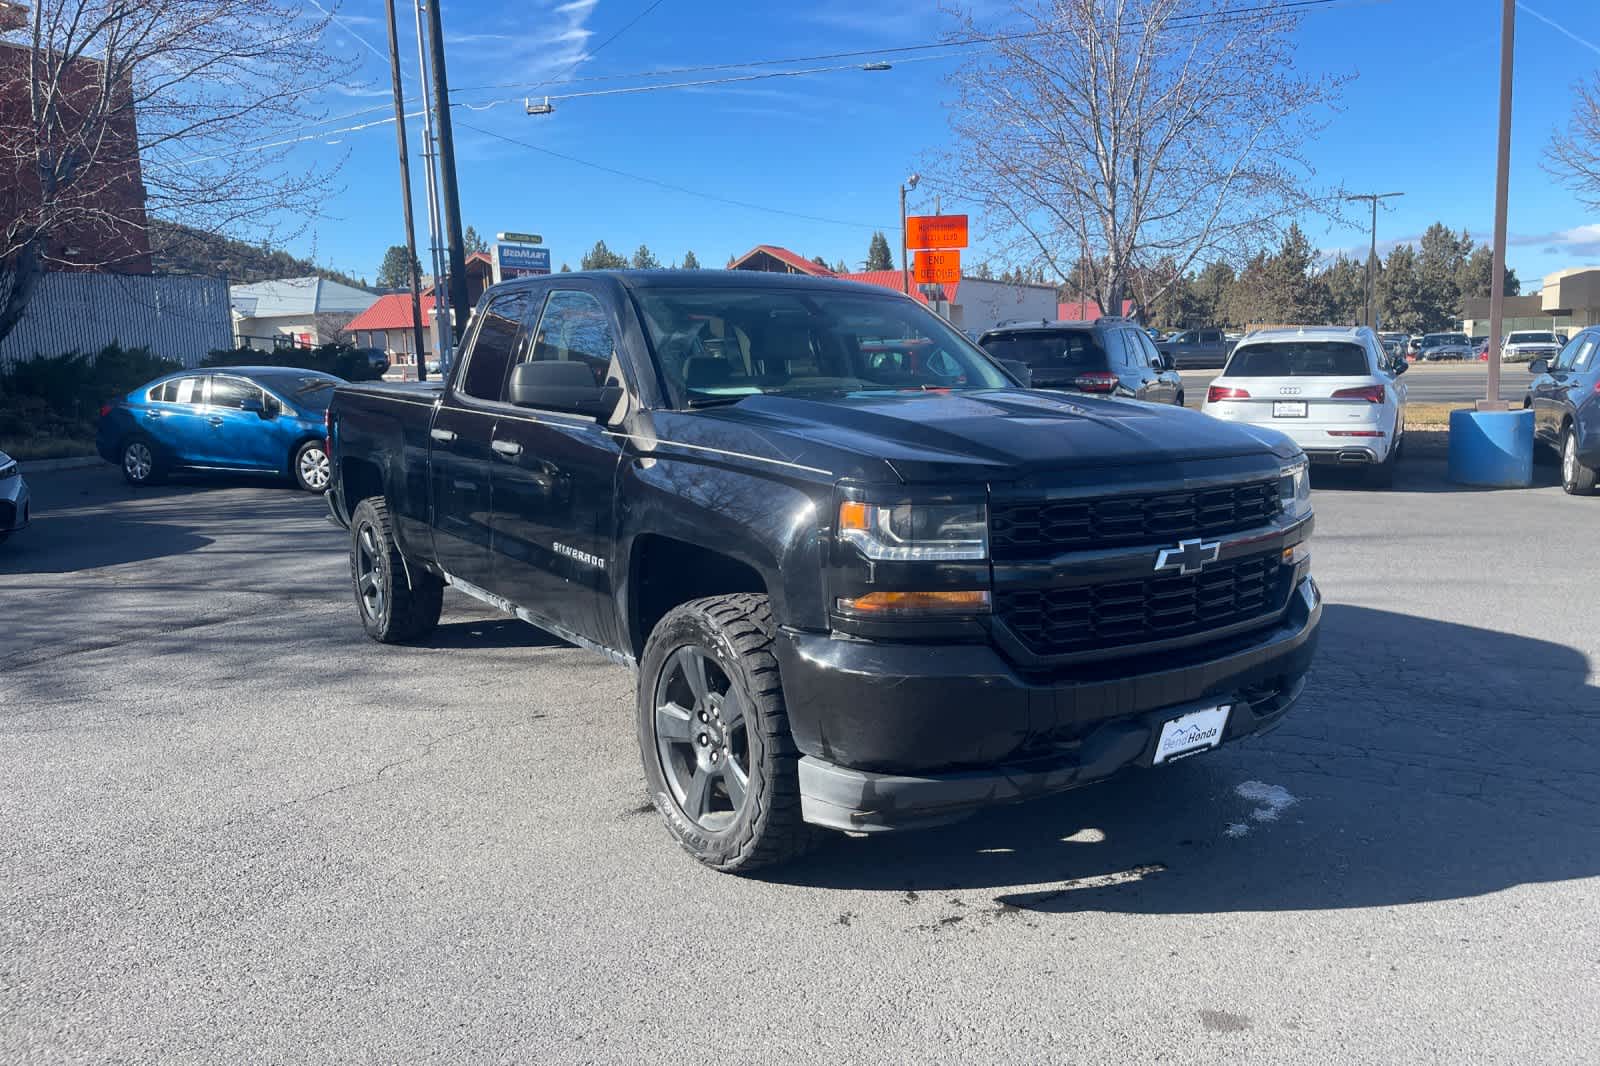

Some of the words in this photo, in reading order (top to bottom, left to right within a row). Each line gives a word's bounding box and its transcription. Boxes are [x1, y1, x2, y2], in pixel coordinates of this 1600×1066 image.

[928, 255, 945, 265] END
[553, 541, 605, 569] SILVERADO
[1187, 727, 1218, 744] Honda
